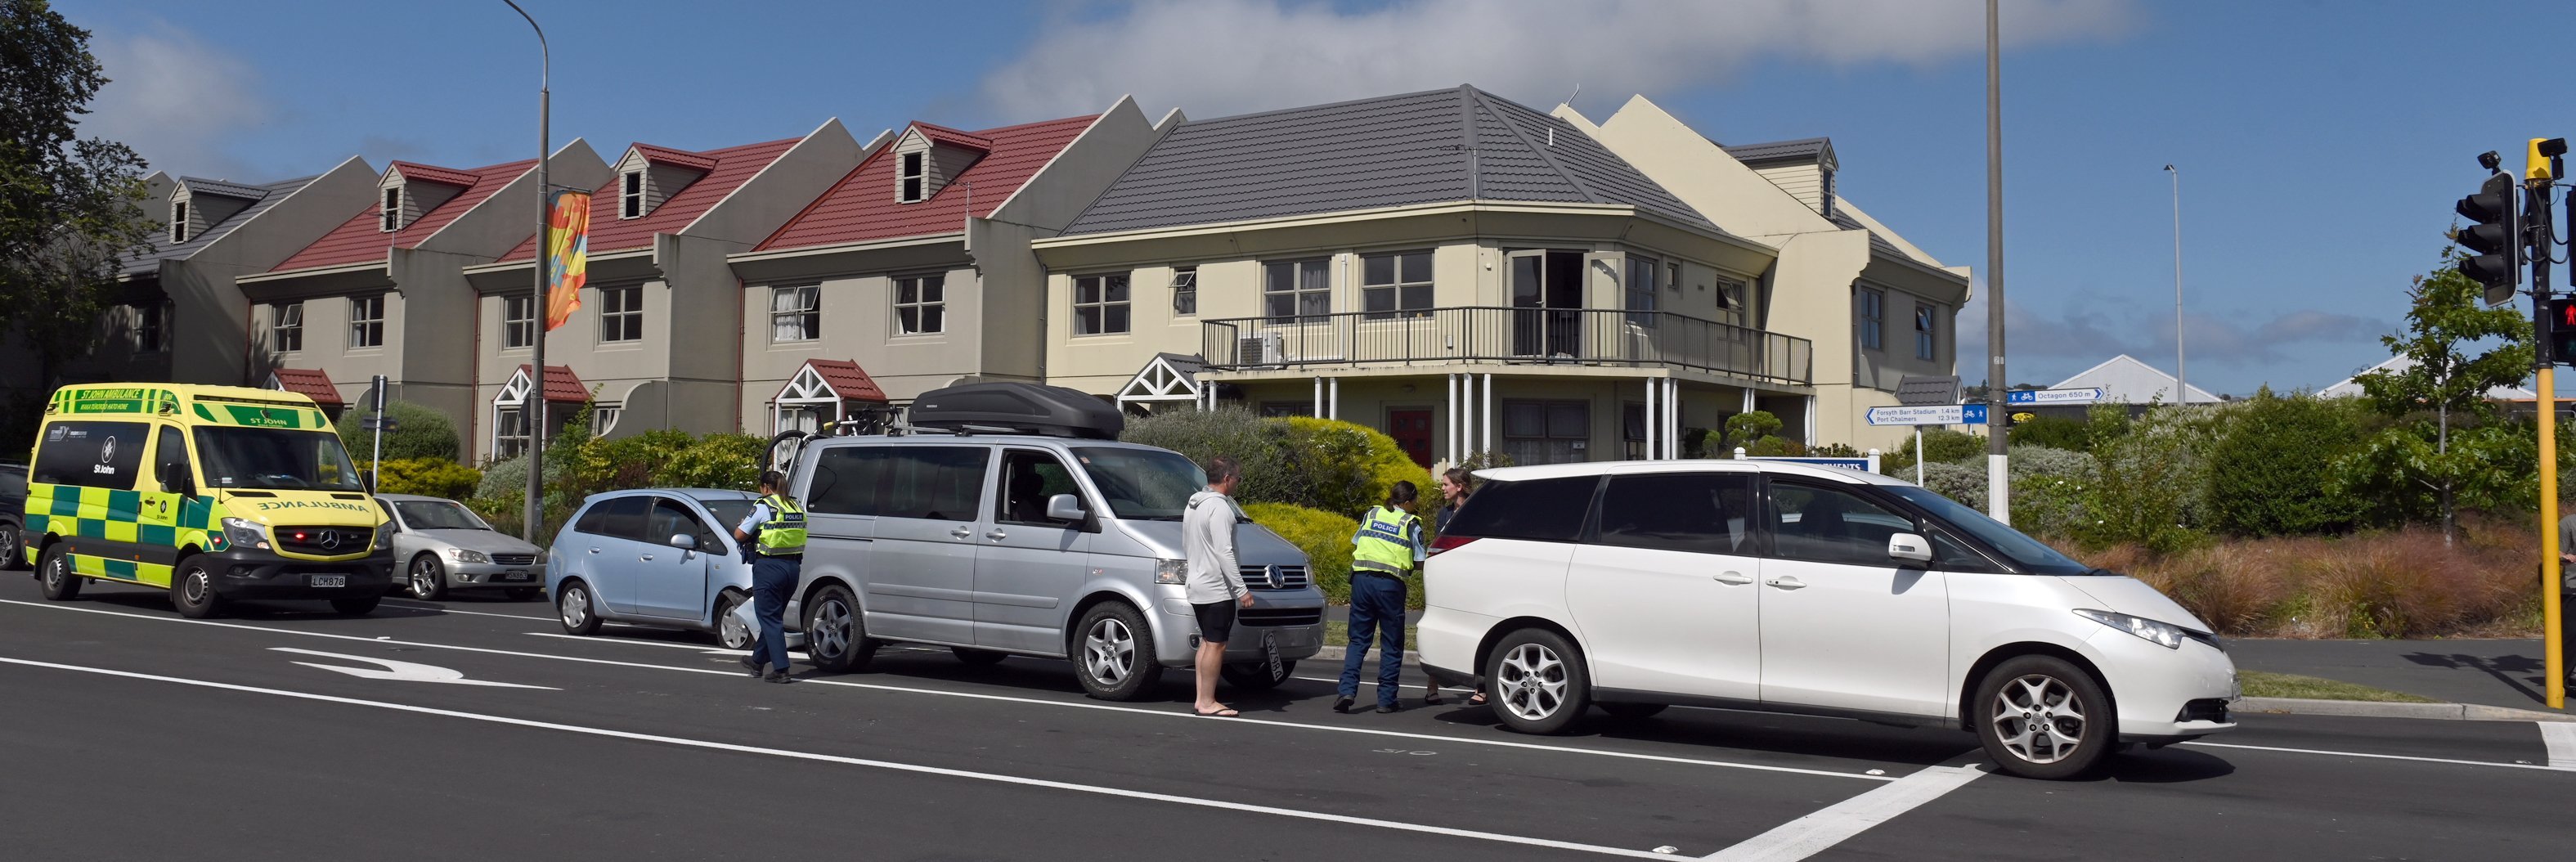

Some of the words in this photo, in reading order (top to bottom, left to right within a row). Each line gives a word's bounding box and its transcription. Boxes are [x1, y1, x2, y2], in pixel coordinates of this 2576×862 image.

[81, 390, 91, 399] ST
[88, 390, 105, 399] JOHN
[104, 388, 141, 399] AMBULANCE
[94, 464, 101, 474] St
[101, 465, 115, 474] John
[1372, 522, 1398, 533] POLICE
[312, 577, 344, 586] LCH878
